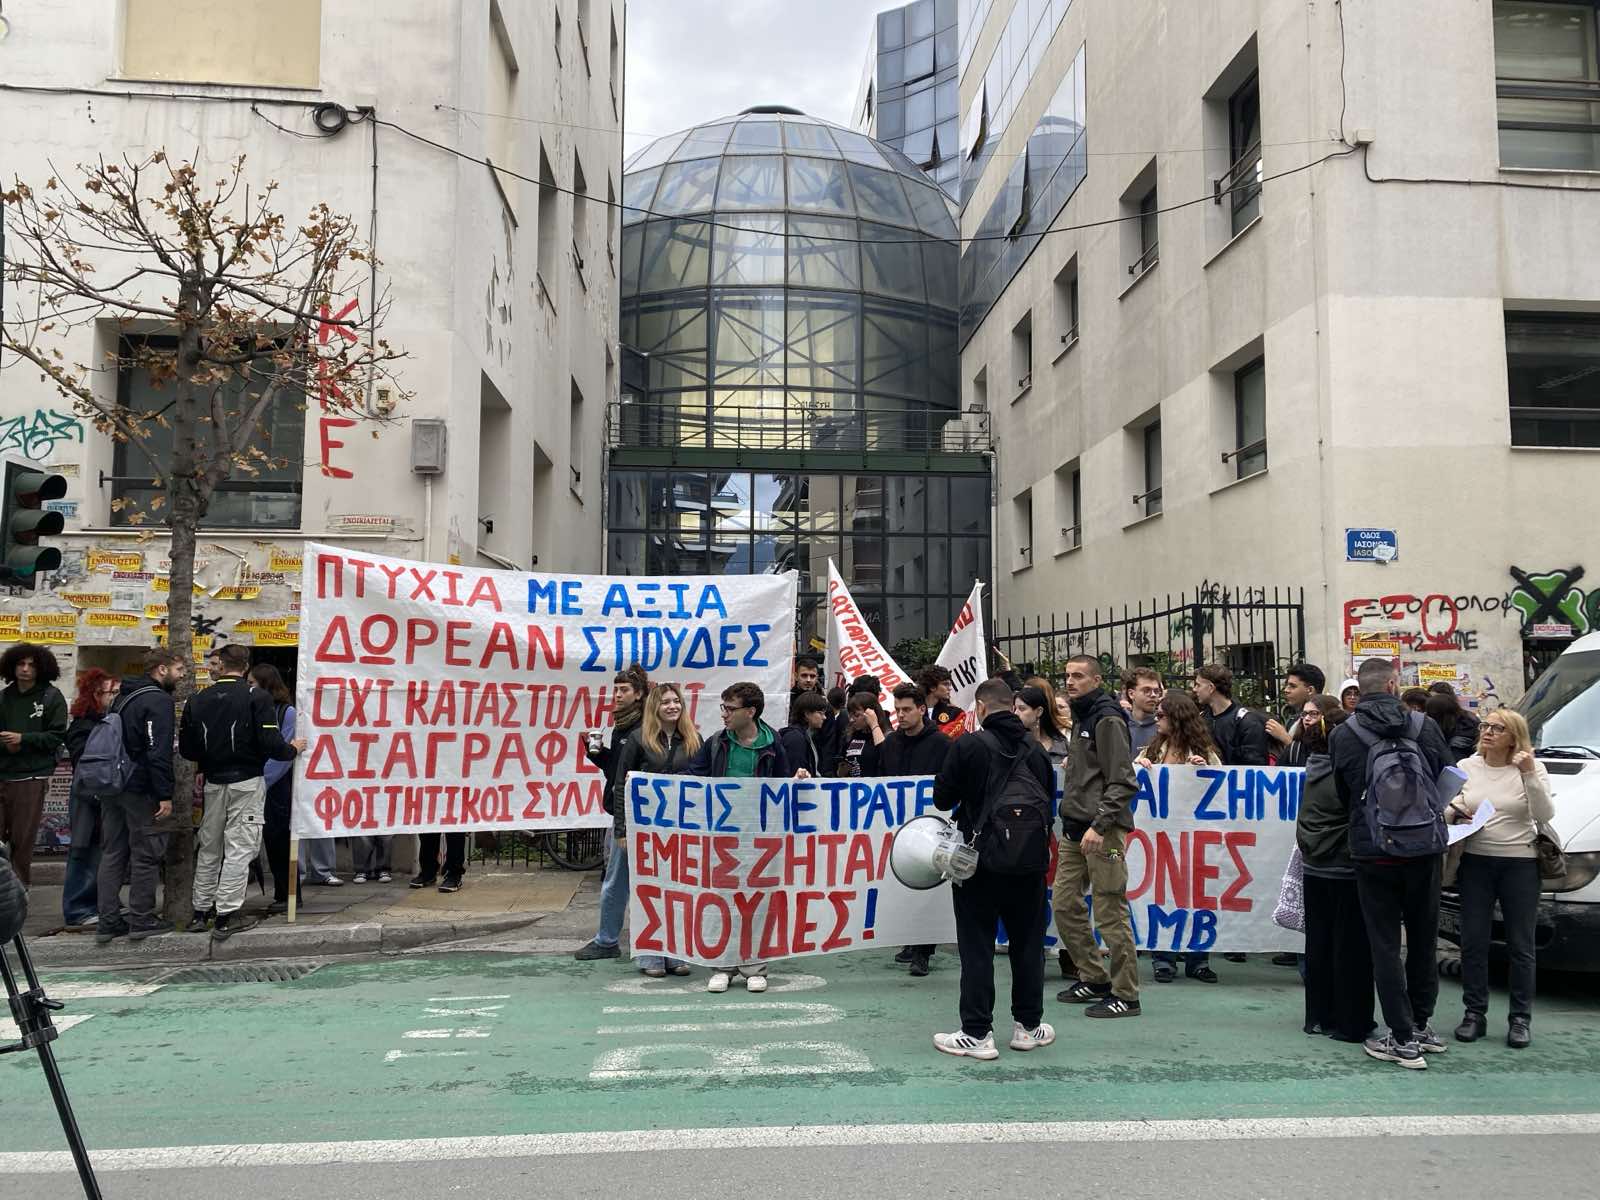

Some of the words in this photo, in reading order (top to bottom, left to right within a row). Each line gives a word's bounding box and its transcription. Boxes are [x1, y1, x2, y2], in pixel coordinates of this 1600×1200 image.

[1354, 549, 1374, 557] IASO
[1360, 531, 1381, 539] ΟΔΟΣ
[317, 553, 503, 613] ΠΤΥΧΙΑ
[527, 579, 584, 616] ΜΕ
[601, 582, 728, 619] ΑΞΙΑ
[314, 613, 565, 671] ΔΩΡΕΑΝ
[579, 623, 771, 672] ΣΠΟΥΔΕΣ
[311, 676, 395, 729] ΟΧΙ
[305, 731, 602, 781] ΔΙΑΓΡΑΦΕ
[313, 783, 514, 831] ΦΟΙΤΗΤΙΚΟΙ
[522, 779, 606, 822] ΣΥΛΛ
[630, 777, 742, 833] ΕΣΕΙΣ
[1131, 766, 1170, 820] ΑΙ
[1193, 767, 1306, 822] ΖΗΜΙ
[635, 831, 742, 890] ΕΜΕΙΣ
[1124, 828, 1257, 913] ΟΝΕΣ
[634, 884, 879, 961] ΣΠΟΥΔΕΣ!
